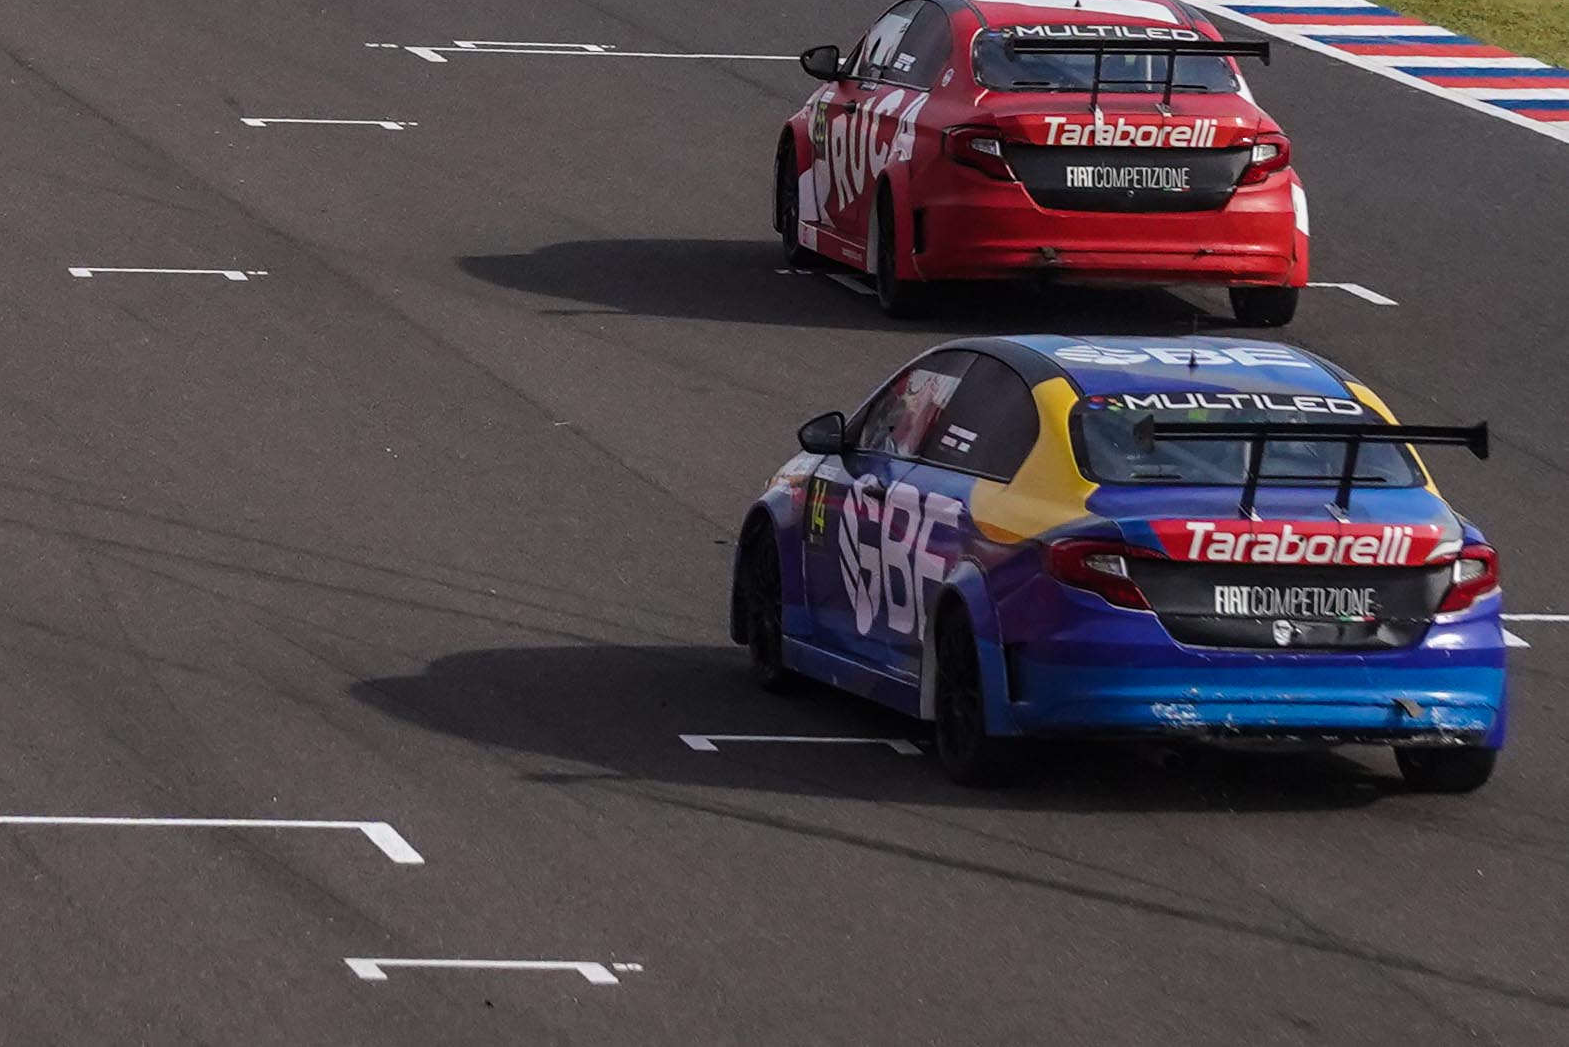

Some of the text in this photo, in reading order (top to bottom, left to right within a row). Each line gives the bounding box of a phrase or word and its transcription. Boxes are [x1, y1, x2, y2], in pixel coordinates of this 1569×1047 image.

[1016, 25, 1199, 42] MULTILED
[1044, 117, 1218, 148] Taraborelli
[1122, 393, 1364, 416] MULTILED
[1186, 522, 1414, 565] Taraborelli
